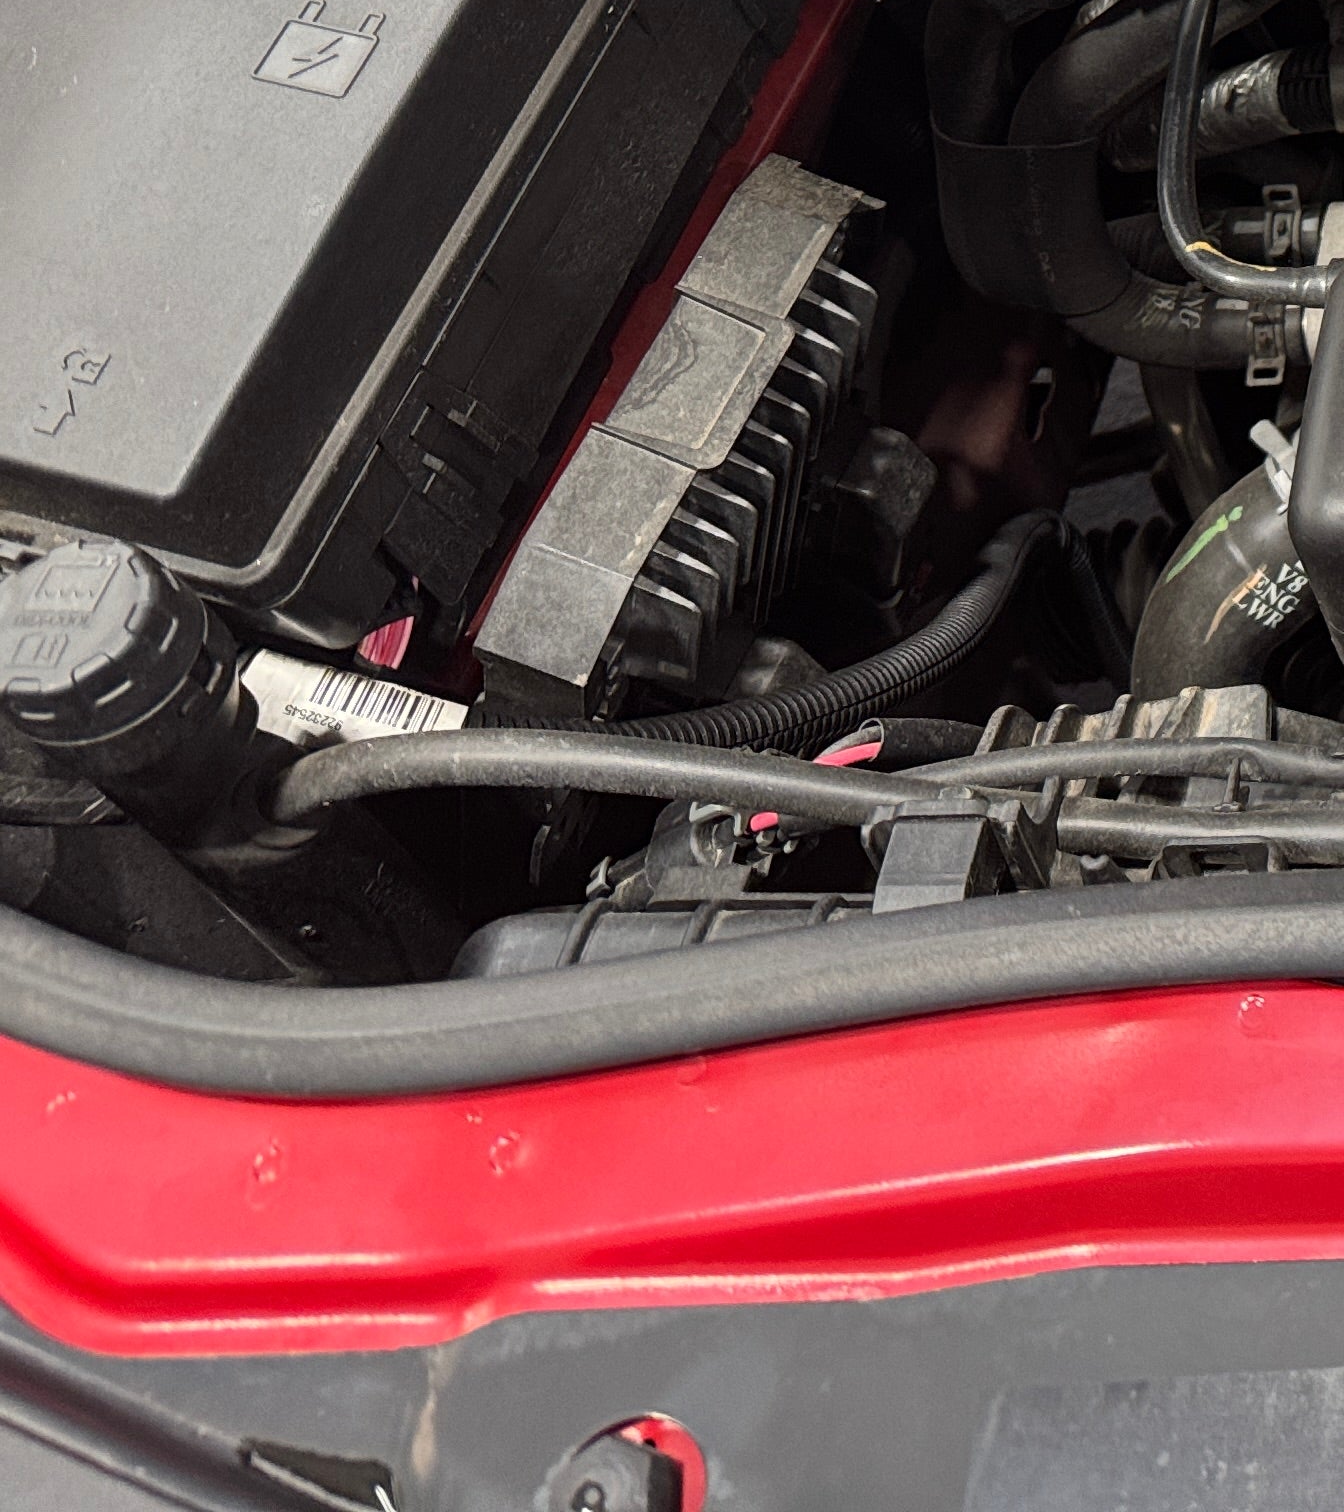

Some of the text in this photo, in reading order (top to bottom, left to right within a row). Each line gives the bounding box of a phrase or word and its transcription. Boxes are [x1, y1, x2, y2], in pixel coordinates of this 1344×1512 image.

[1245, 568, 1301, 615] ENG
[1276, 562, 1309, 594] V8
[1231, 586, 1285, 629] LWR
